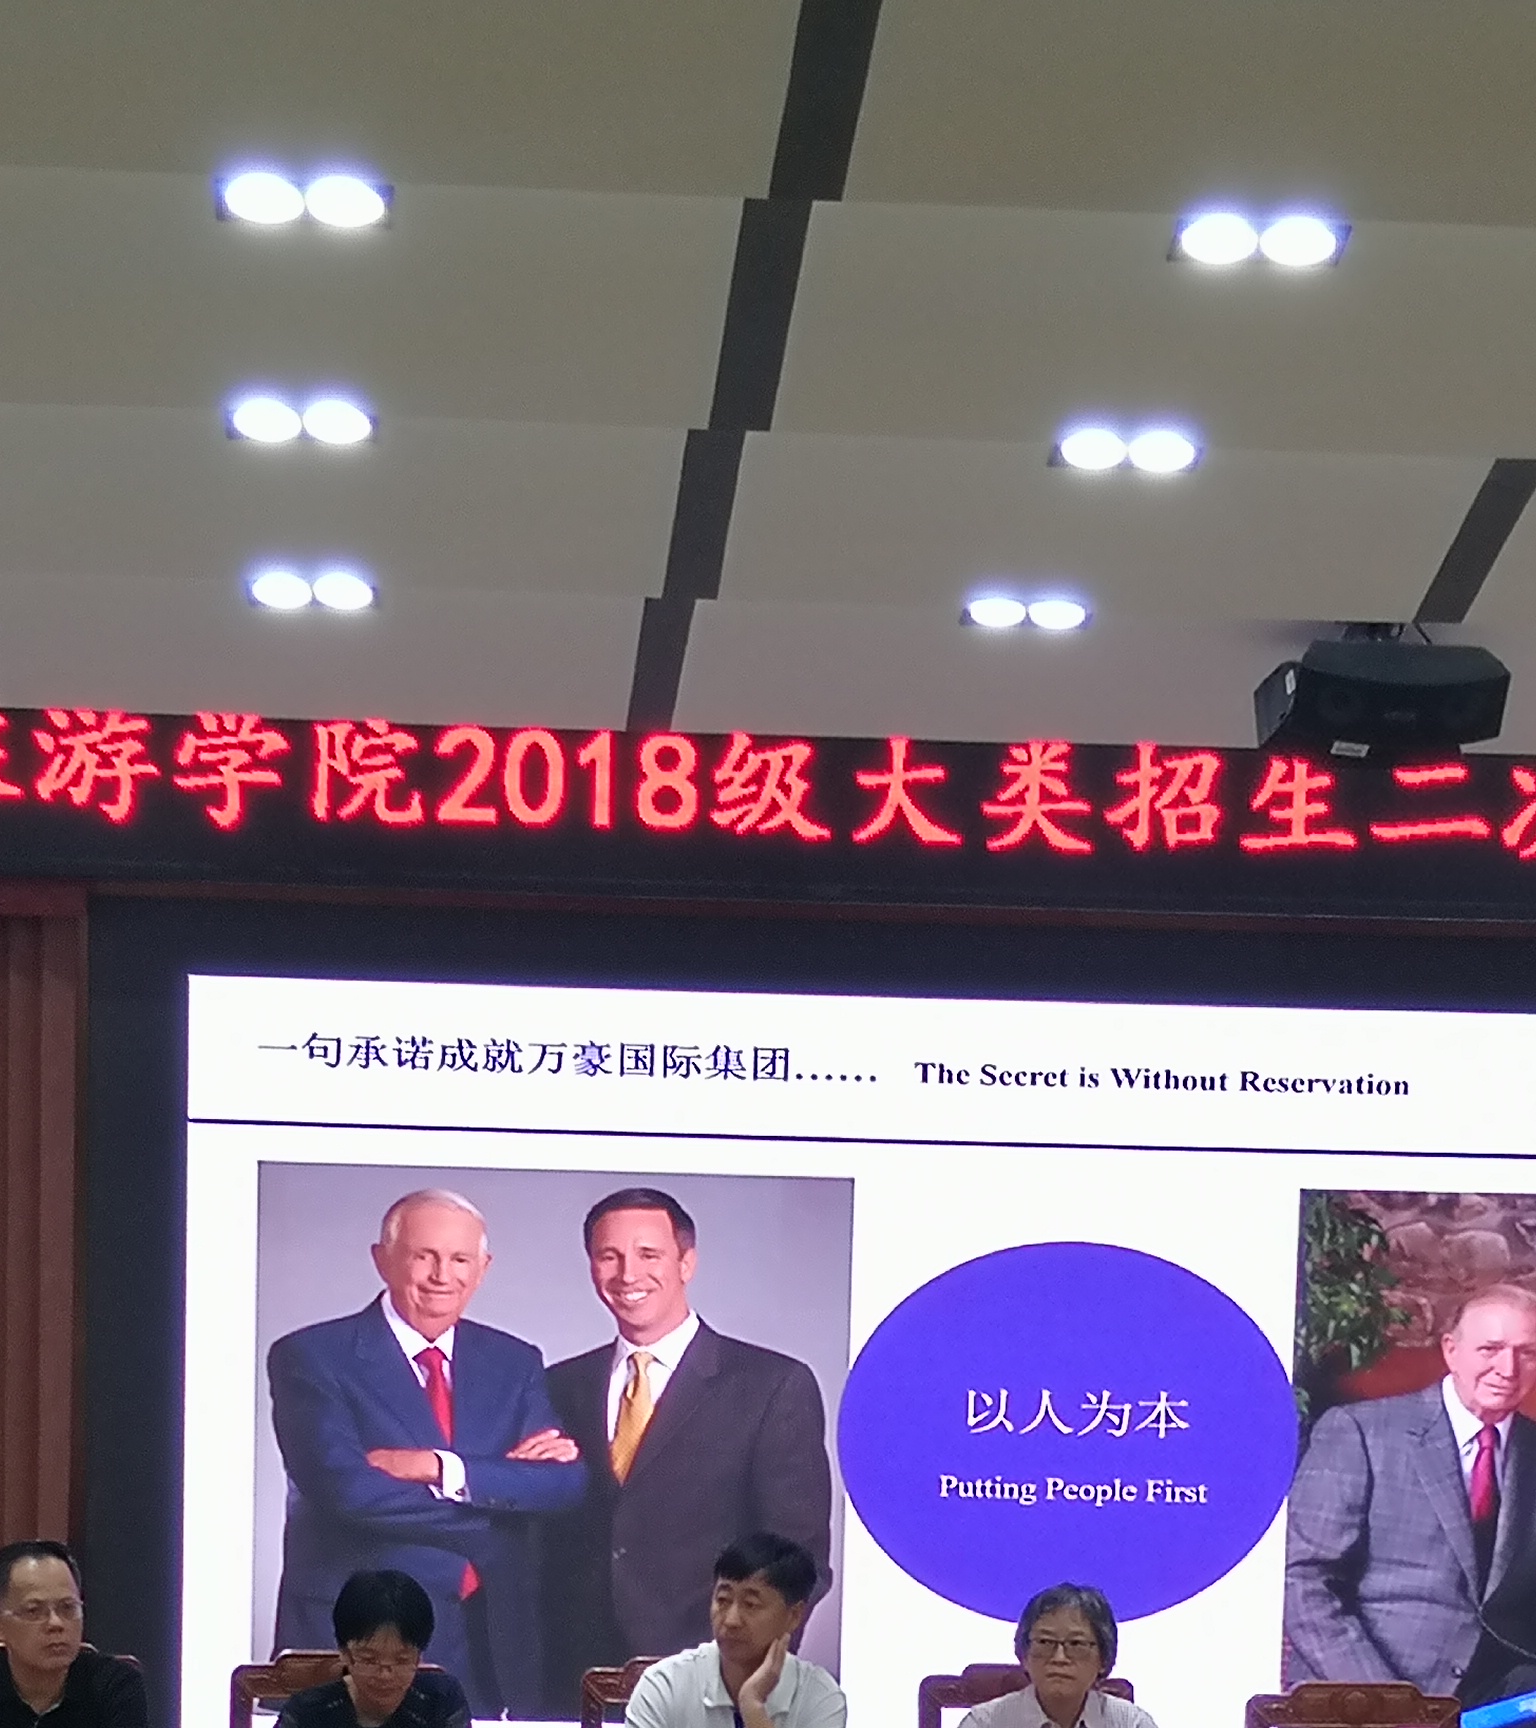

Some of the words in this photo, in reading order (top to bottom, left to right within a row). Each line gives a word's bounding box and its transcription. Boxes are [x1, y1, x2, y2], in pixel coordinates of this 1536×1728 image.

[915, 1061, 970, 1085] The
[980, 1064, 1069, 1087] Secret
[1078, 1067, 1100, 1089] is
[1110, 1068, 1228, 1091] Without
[1240, 1071, 1410, 1096] Reservation
[964, 1388, 1191, 1440] 以人为本
[938, 1474, 1038, 1506] Putting
[1045, 1477, 1138, 1507] People
[1145, 1479, 1208, 1504] First
